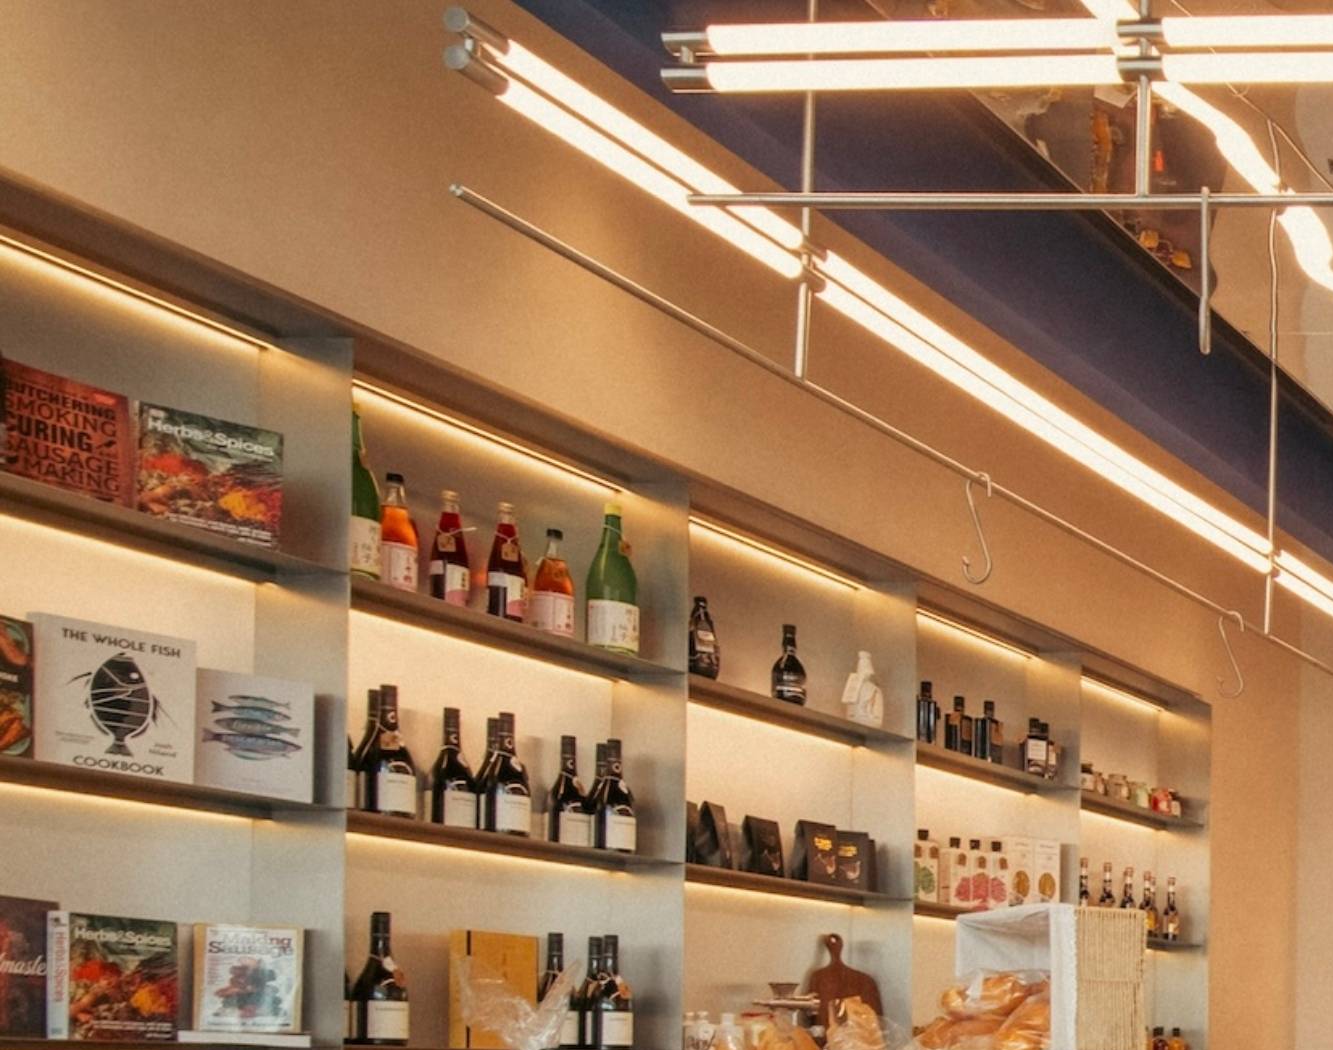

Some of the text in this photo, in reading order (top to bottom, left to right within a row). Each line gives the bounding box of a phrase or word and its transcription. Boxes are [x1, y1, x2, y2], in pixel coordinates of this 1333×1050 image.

[23, 460, 119, 492] MAKING
[62, 628, 181, 658] THE WHOLE FISH
[73, 755, 164, 777] COOKBOOK
